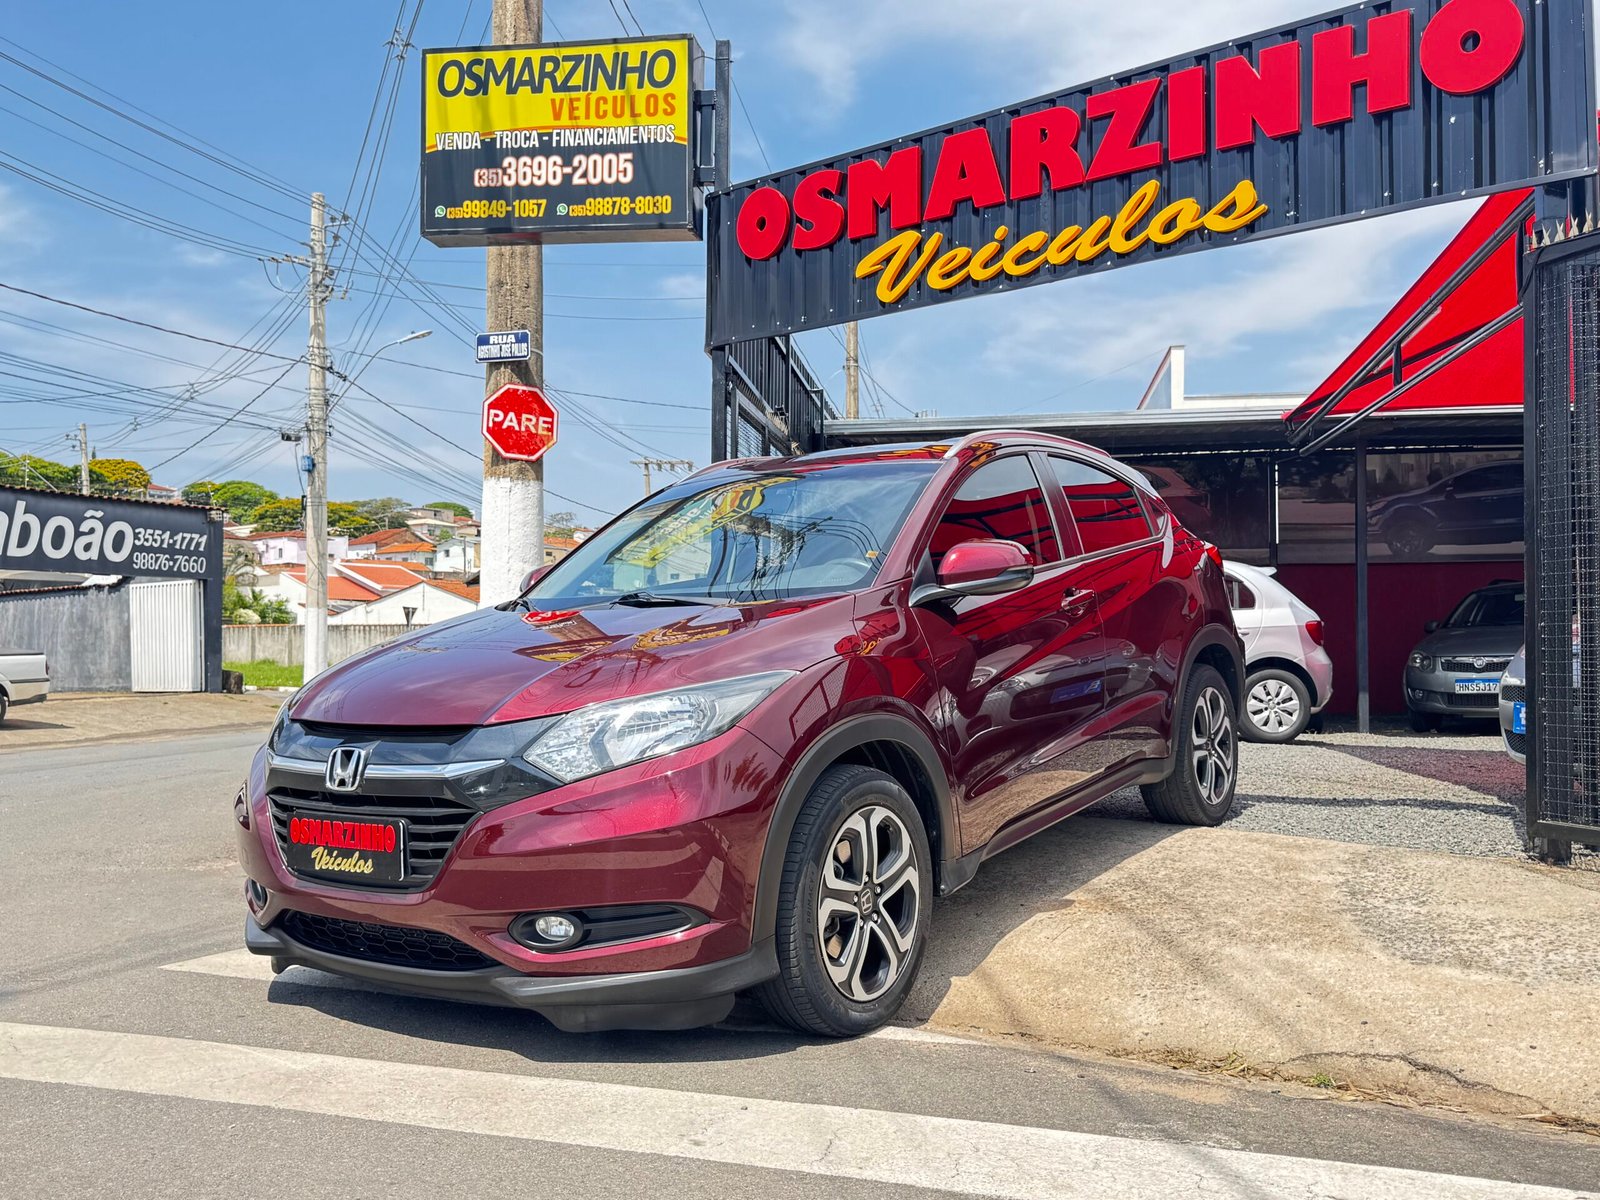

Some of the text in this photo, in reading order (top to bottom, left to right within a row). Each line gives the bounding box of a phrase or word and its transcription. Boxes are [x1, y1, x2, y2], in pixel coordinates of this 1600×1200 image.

[436, 49, 677, 98] OSMARZINHO
[550, 92, 677, 121] VEÍCULOS
[436, 132, 481, 150] VENDA
[494, 131, 539, 148] TROCA
[552, 124, 676, 147] FINANCIAMENTOS
[736, 0, 1525, 261] OSMARZINHO
[473, 152, 634, 188] (35)3696-2005
[855, 179, 1268, 304] Veiculos
[489, 335, 516, 344] RUA
[488, 409, 553, 436] PARE
[290, 817, 396, 853] OSMARZINHO
